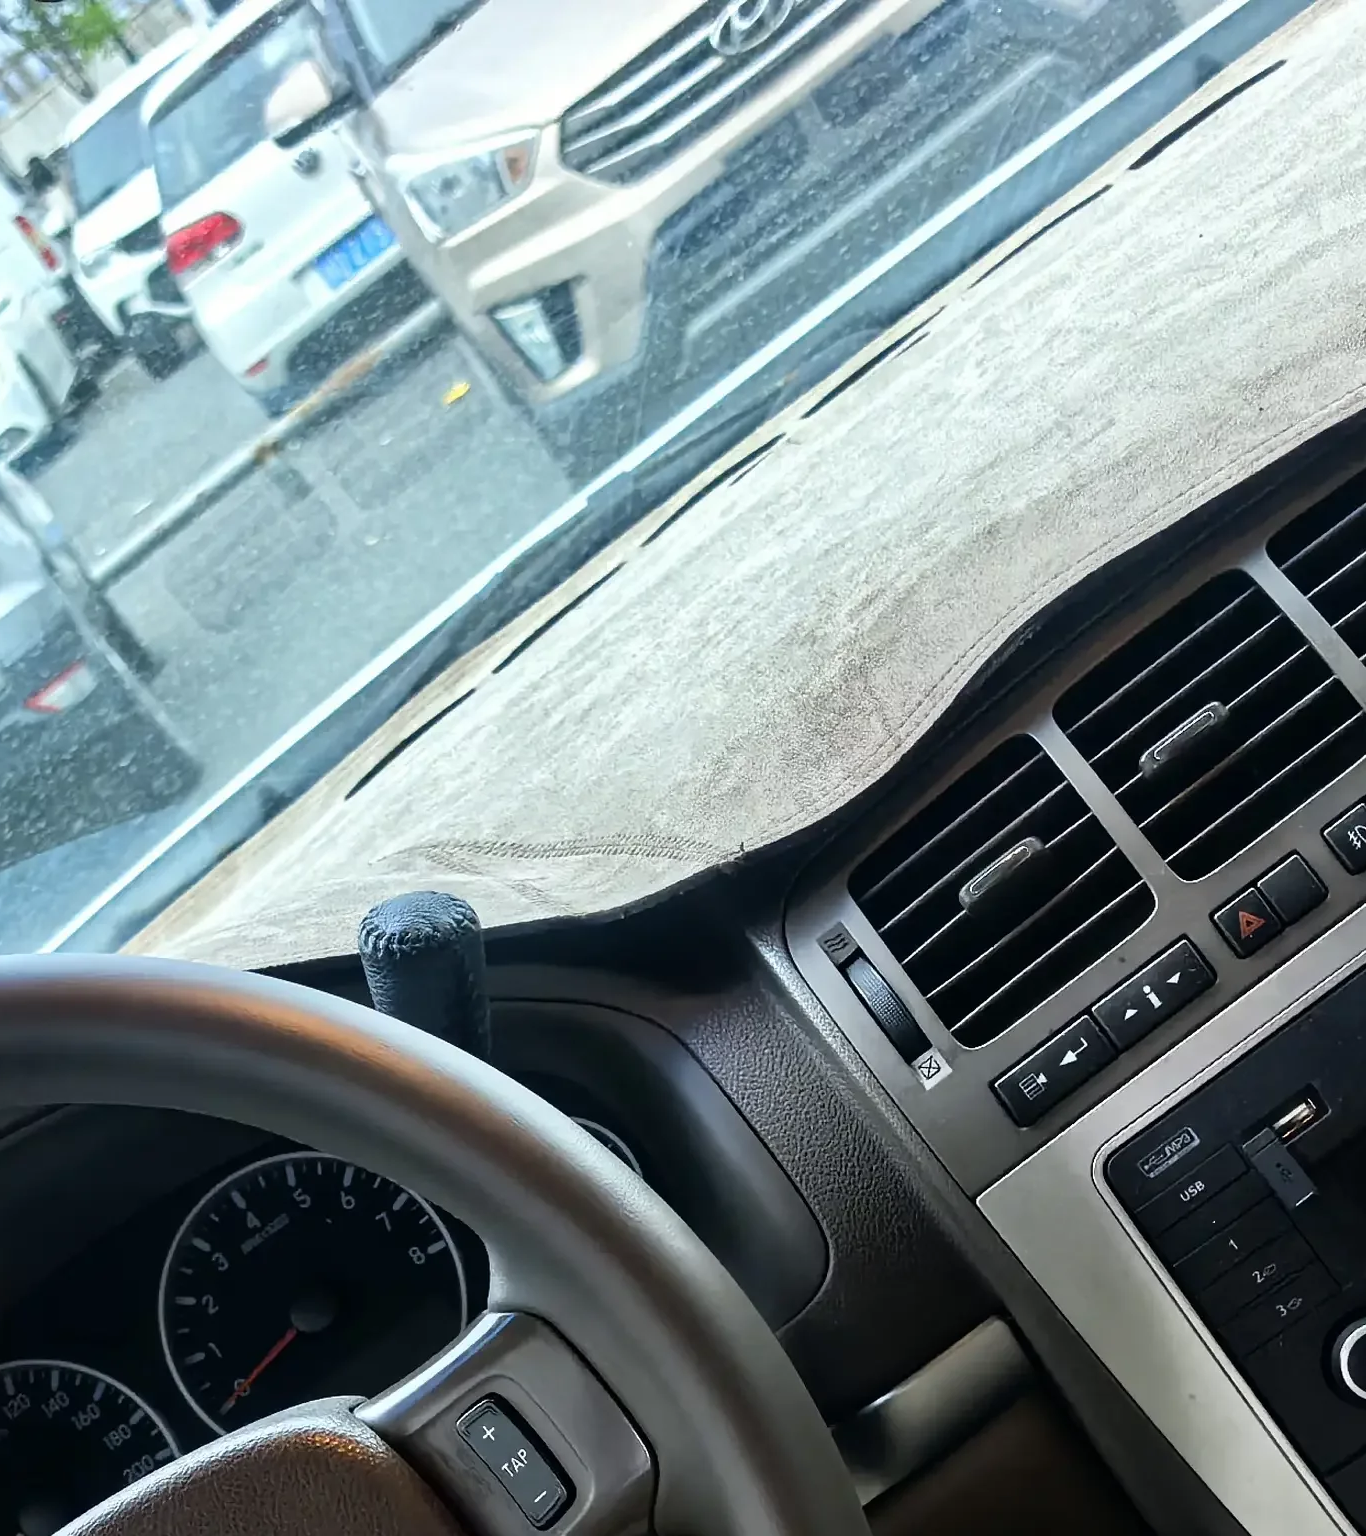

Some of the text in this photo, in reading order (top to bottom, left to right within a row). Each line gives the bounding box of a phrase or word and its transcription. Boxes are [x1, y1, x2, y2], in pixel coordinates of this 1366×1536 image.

[293, 1188, 311, 1208] 5
[340, 1190, 356, 1210] 6
[1179, 1180, 1205, 1202] USB
[245, 1211, 262, 1229] 4
[375, 1212, 392, 1232] 7
[1229, 1238, 1238, 1250] 1
[211, 1252, 229, 1271] 3
[408, 1246, 426, 1265] 8
[1252, 1270, 1264, 1283] 2
[201, 1294, 219, 1315] 2
[1275, 1304, 1287, 1317] 3
[2, 1392, 31, 1420] 120
[41, 1391, 70, 1419] 140
[71, 1404, 101, 1430] 160
[102, 1424, 132, 1450] 180
[123, 1454, 155, 1482] 200
[501, 1448, 528, 1477] TAP
